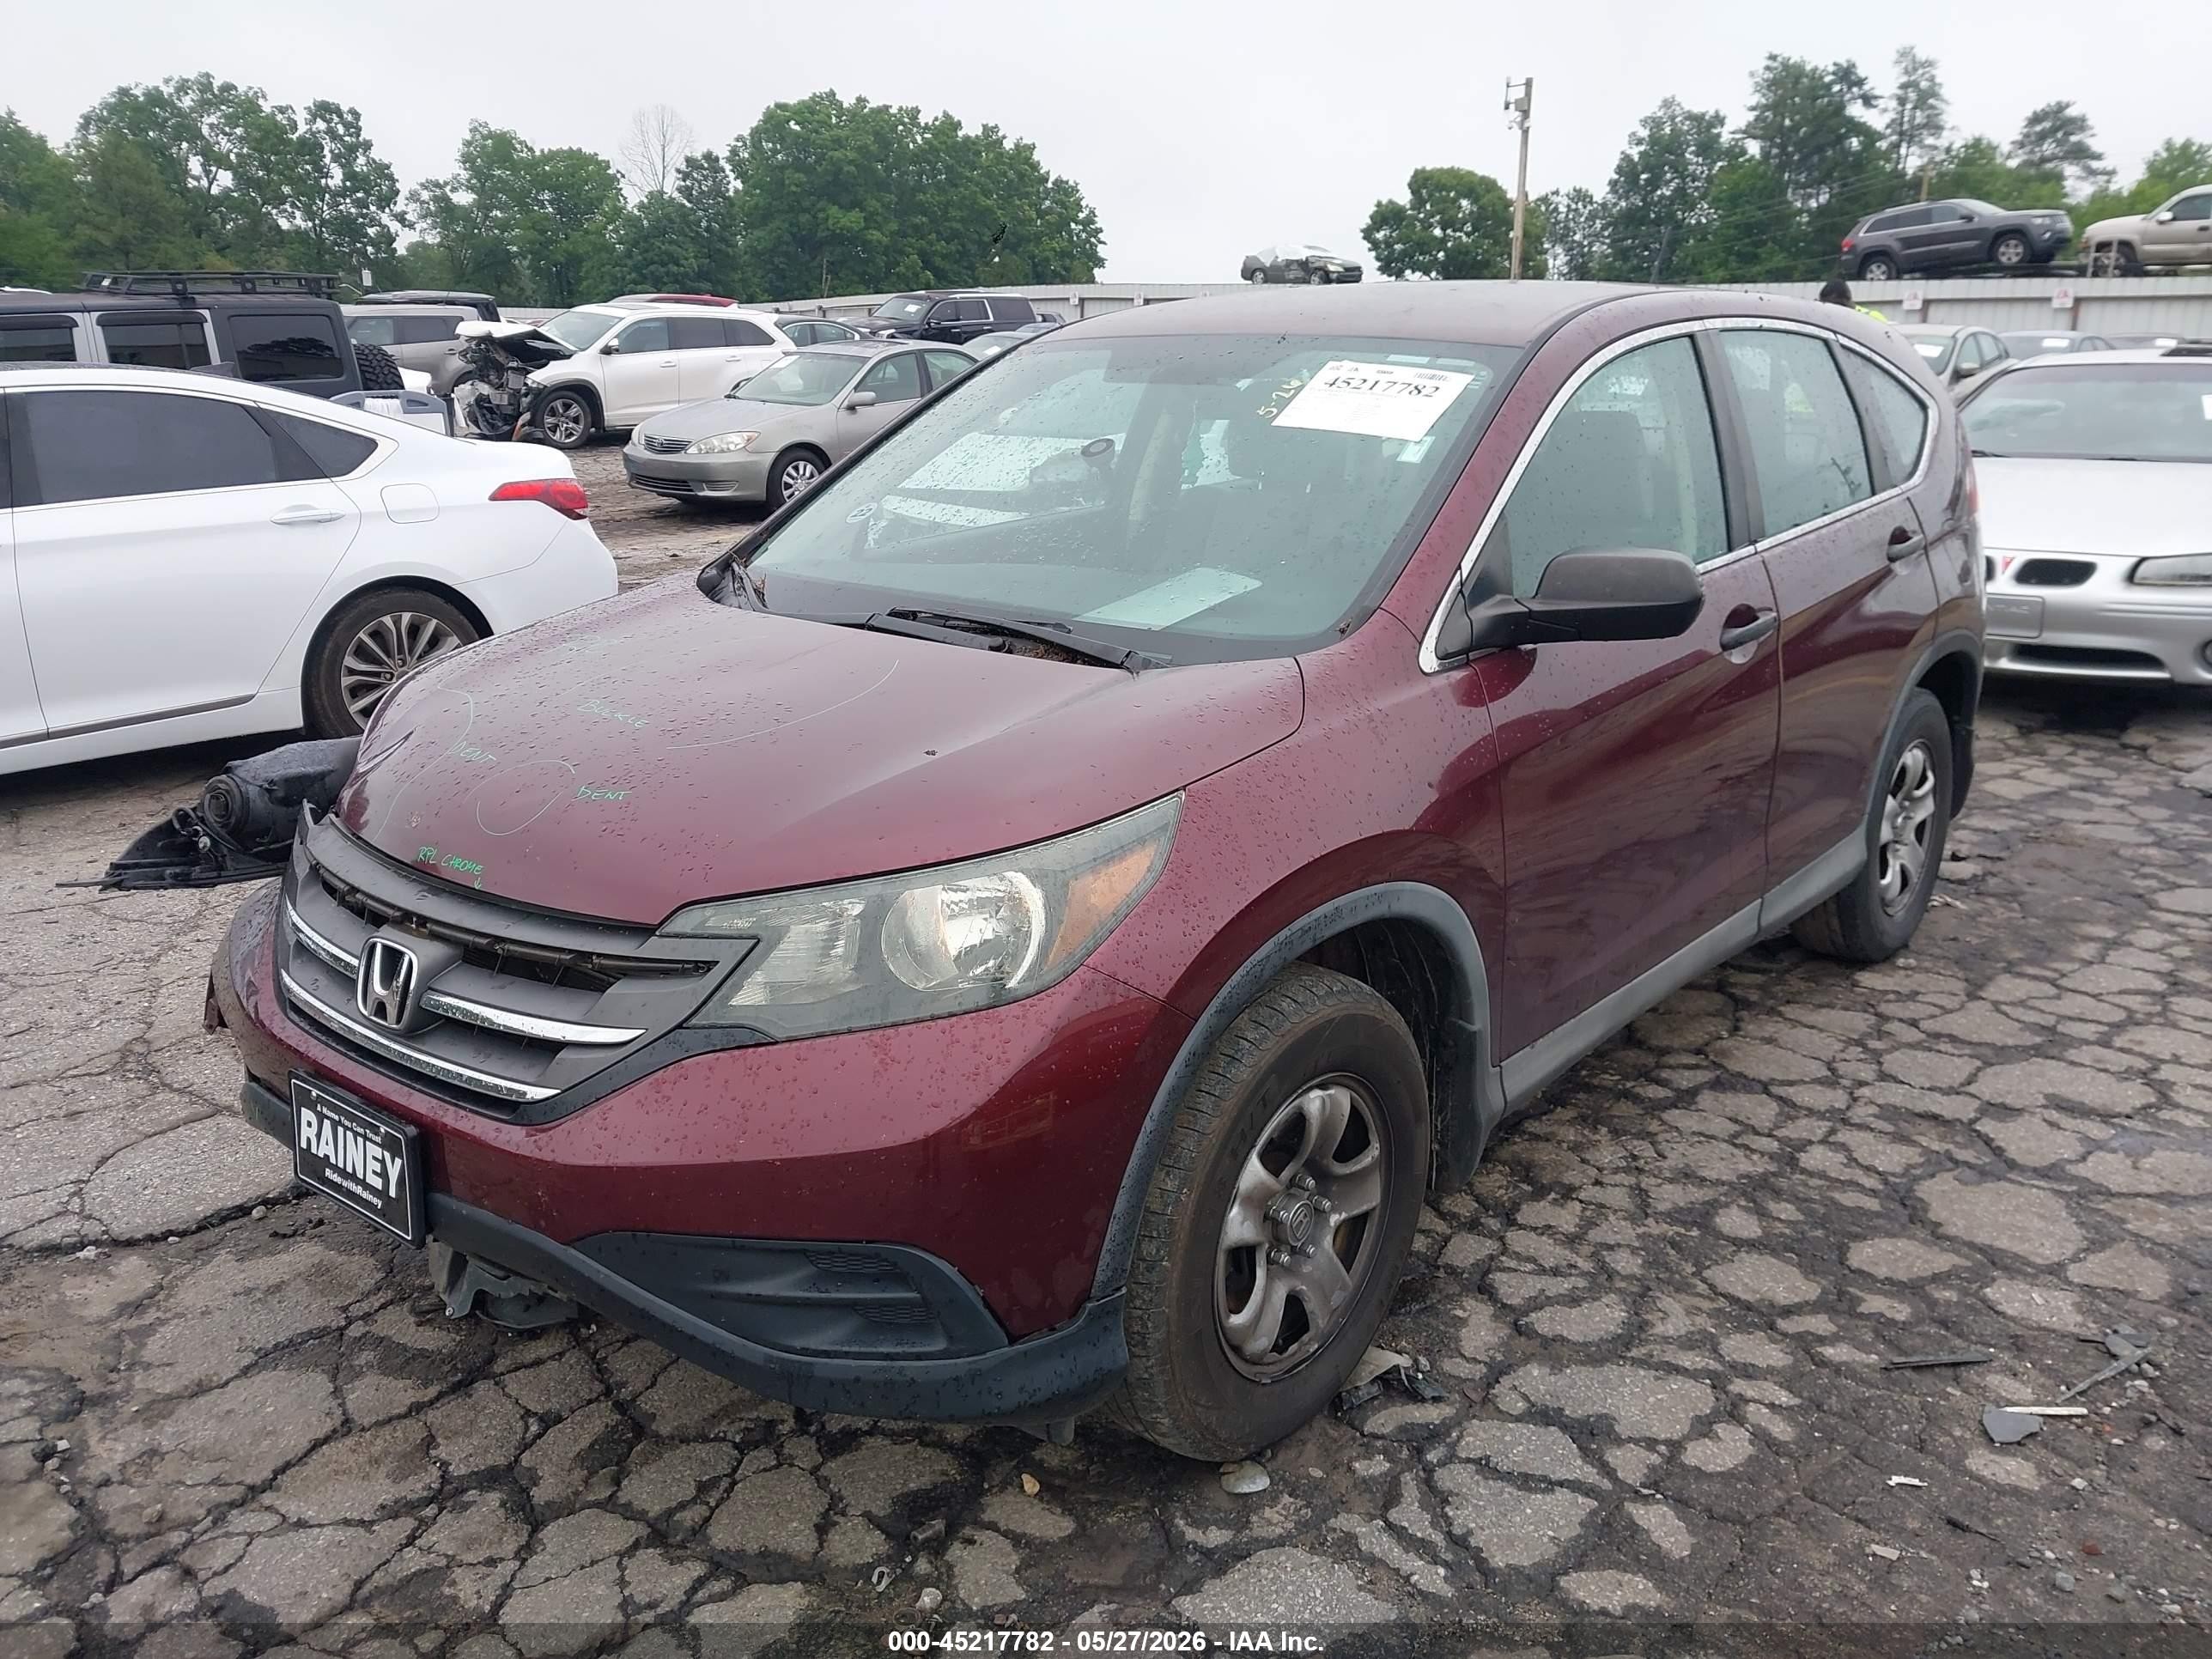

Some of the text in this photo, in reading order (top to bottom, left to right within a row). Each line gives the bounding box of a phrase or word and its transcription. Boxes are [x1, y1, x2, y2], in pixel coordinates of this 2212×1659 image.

[1323, 376, 1440, 398] 45217782
[448, 741, 496, 763] DENT
[571, 786, 633, 802] DENT
[316, 1103, 382, 1145] A Name You Can Trust
[301, 1106, 403, 1199] RAINEY
[325, 1167, 383, 1210] RidewithRainey
